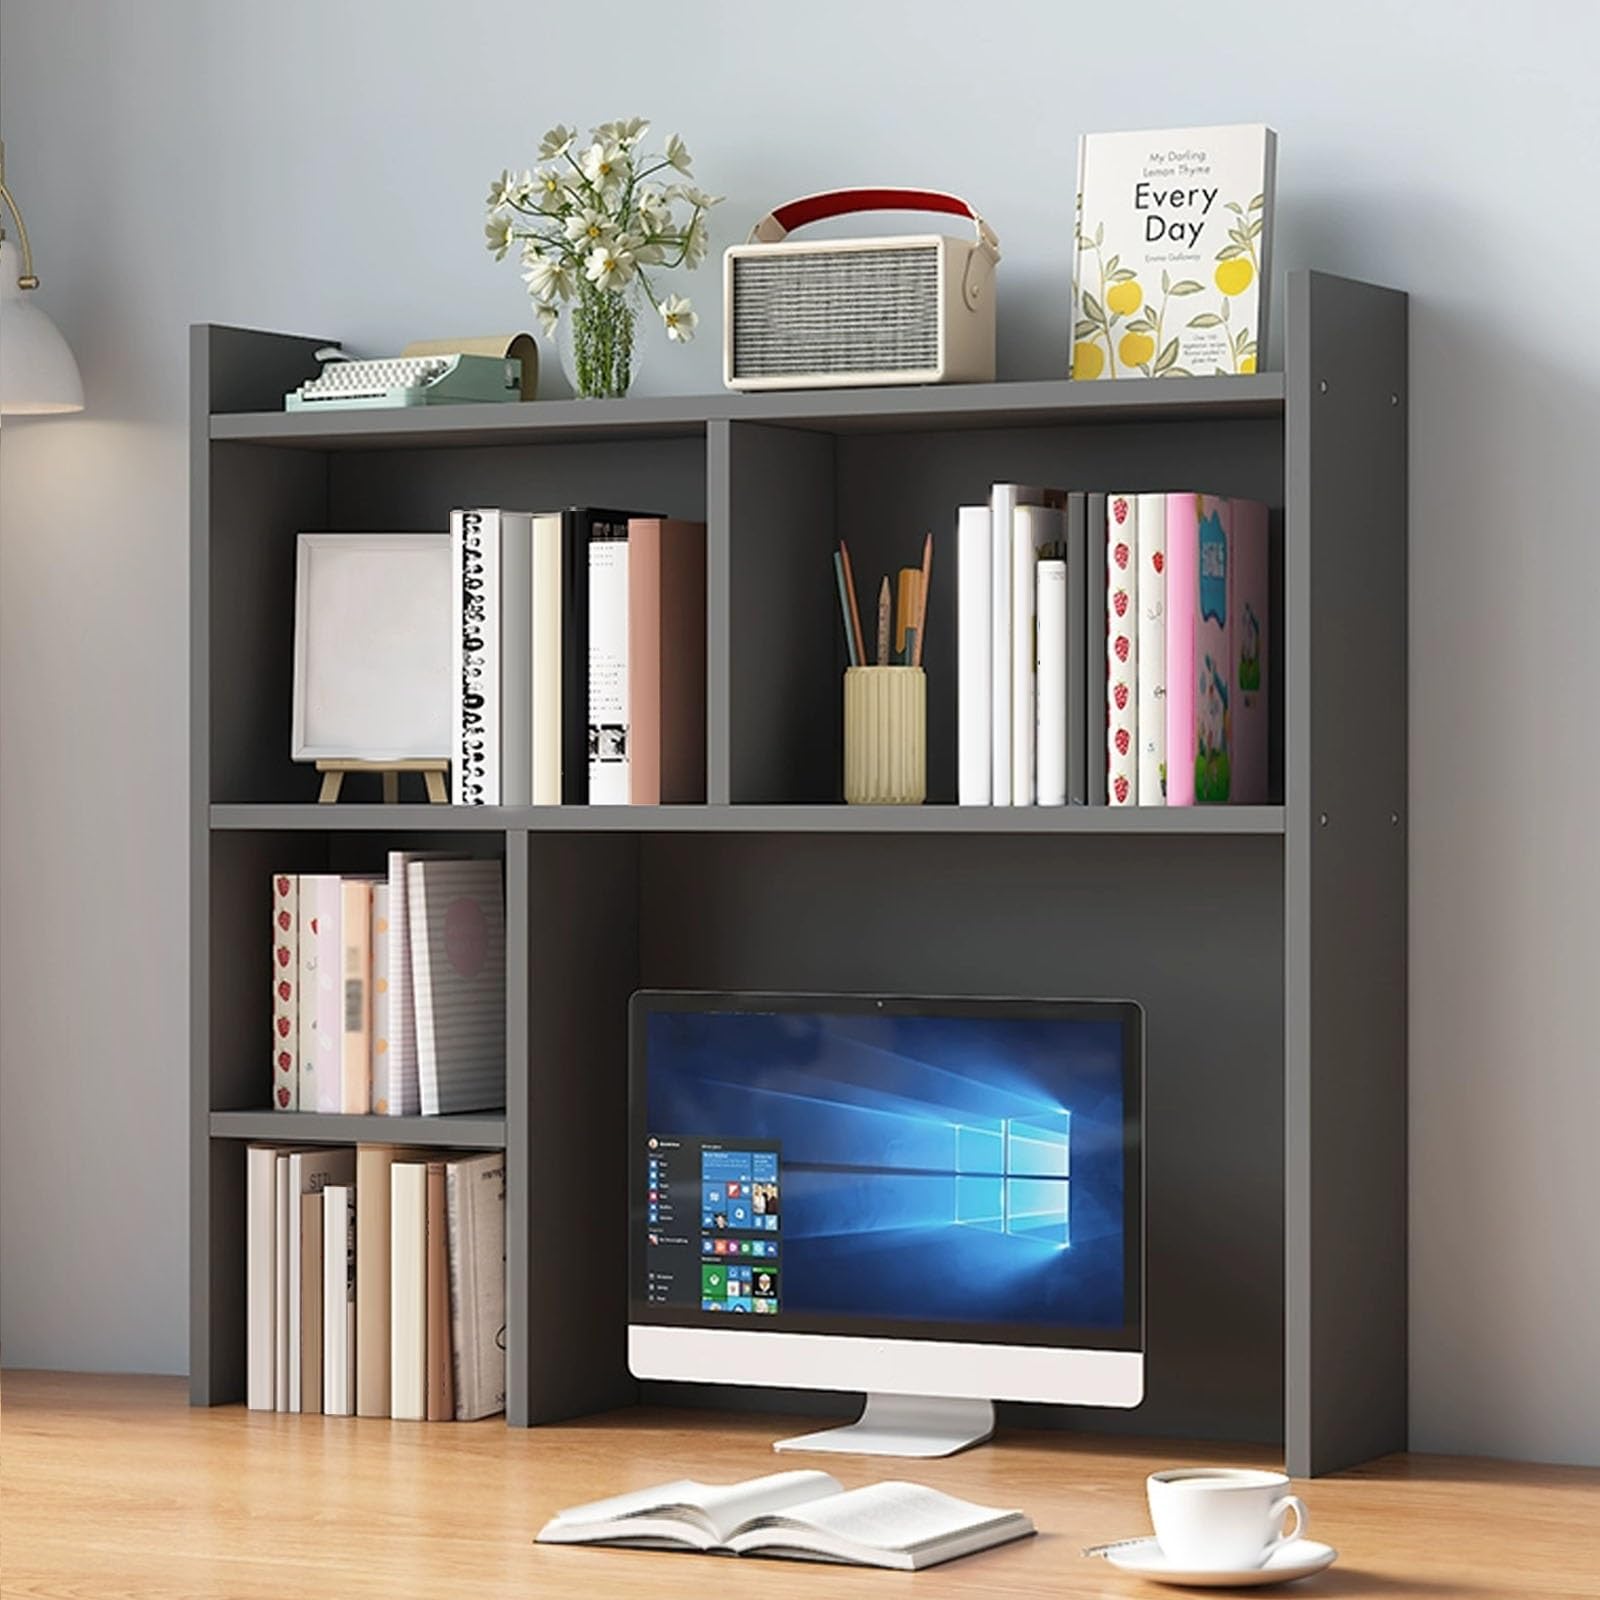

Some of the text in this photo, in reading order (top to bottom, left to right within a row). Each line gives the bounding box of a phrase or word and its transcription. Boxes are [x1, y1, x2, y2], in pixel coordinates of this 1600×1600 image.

[1150, 150, 1206, 164] My Darling
[1143, 164, 1210, 177] Lemon Thyme
[1135, 182, 1218, 215] Every
[1146, 214, 1205, 249] Day
